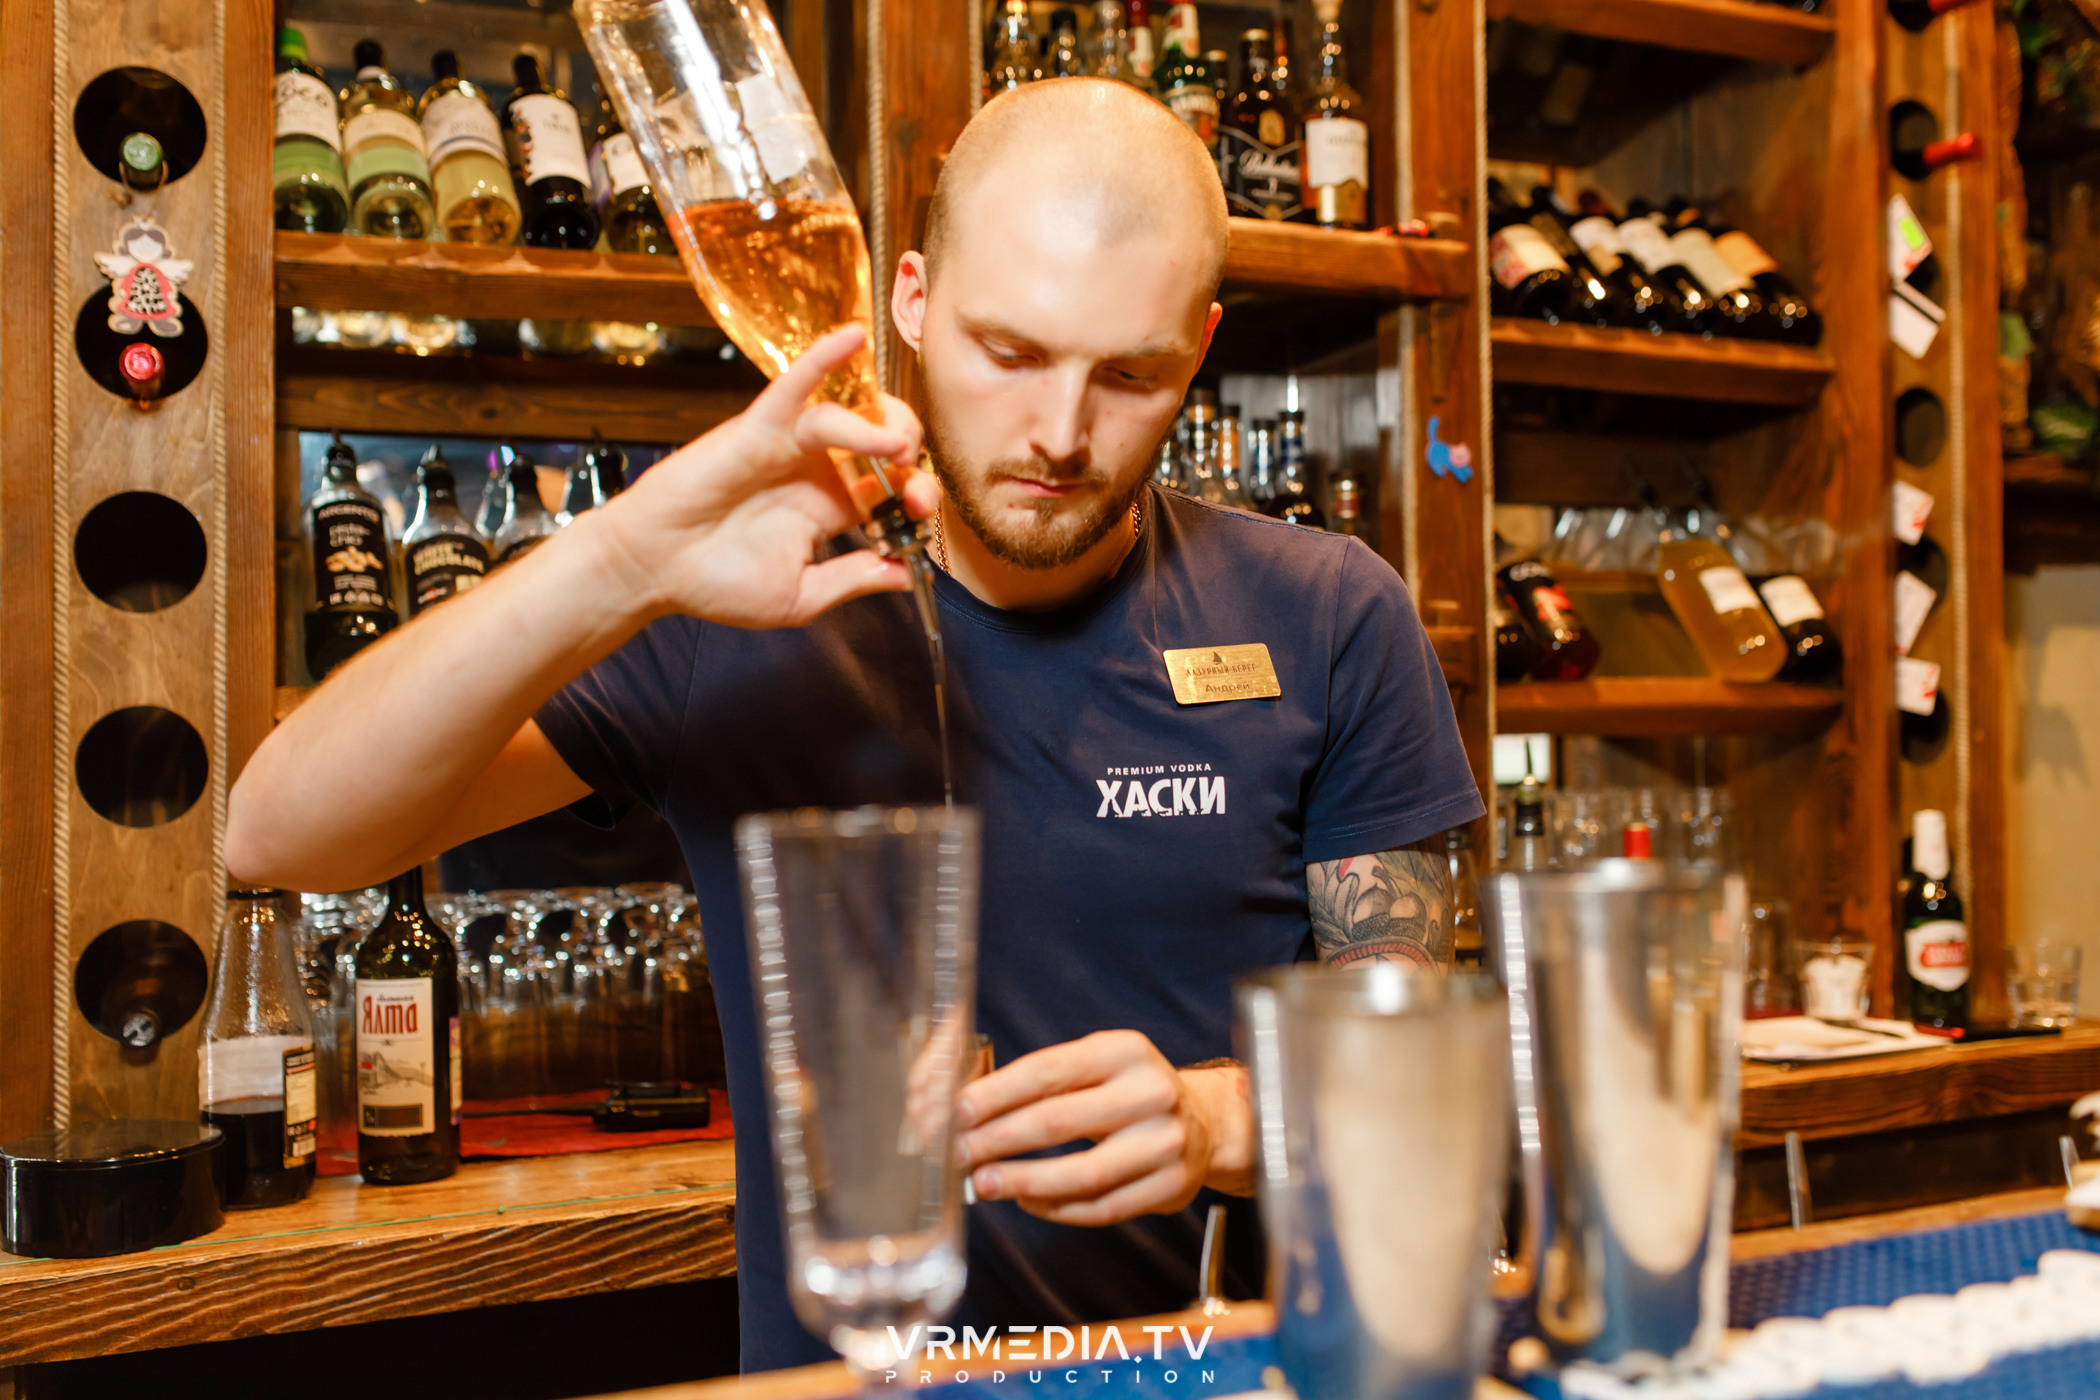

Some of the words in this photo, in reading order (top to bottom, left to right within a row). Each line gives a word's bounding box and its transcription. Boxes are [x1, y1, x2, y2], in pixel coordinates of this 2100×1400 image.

[1232, 663, 1256, 674] БЕРЕГ
[1205, 682, 1250, 694] Андрей
[1107, 765, 1165, 776] PREMIUM
[1170, 763, 1212, 773] VODKA
[1096, 776, 1226, 818] ХАСКИ
[362, 995, 418, 1035] Ялта
